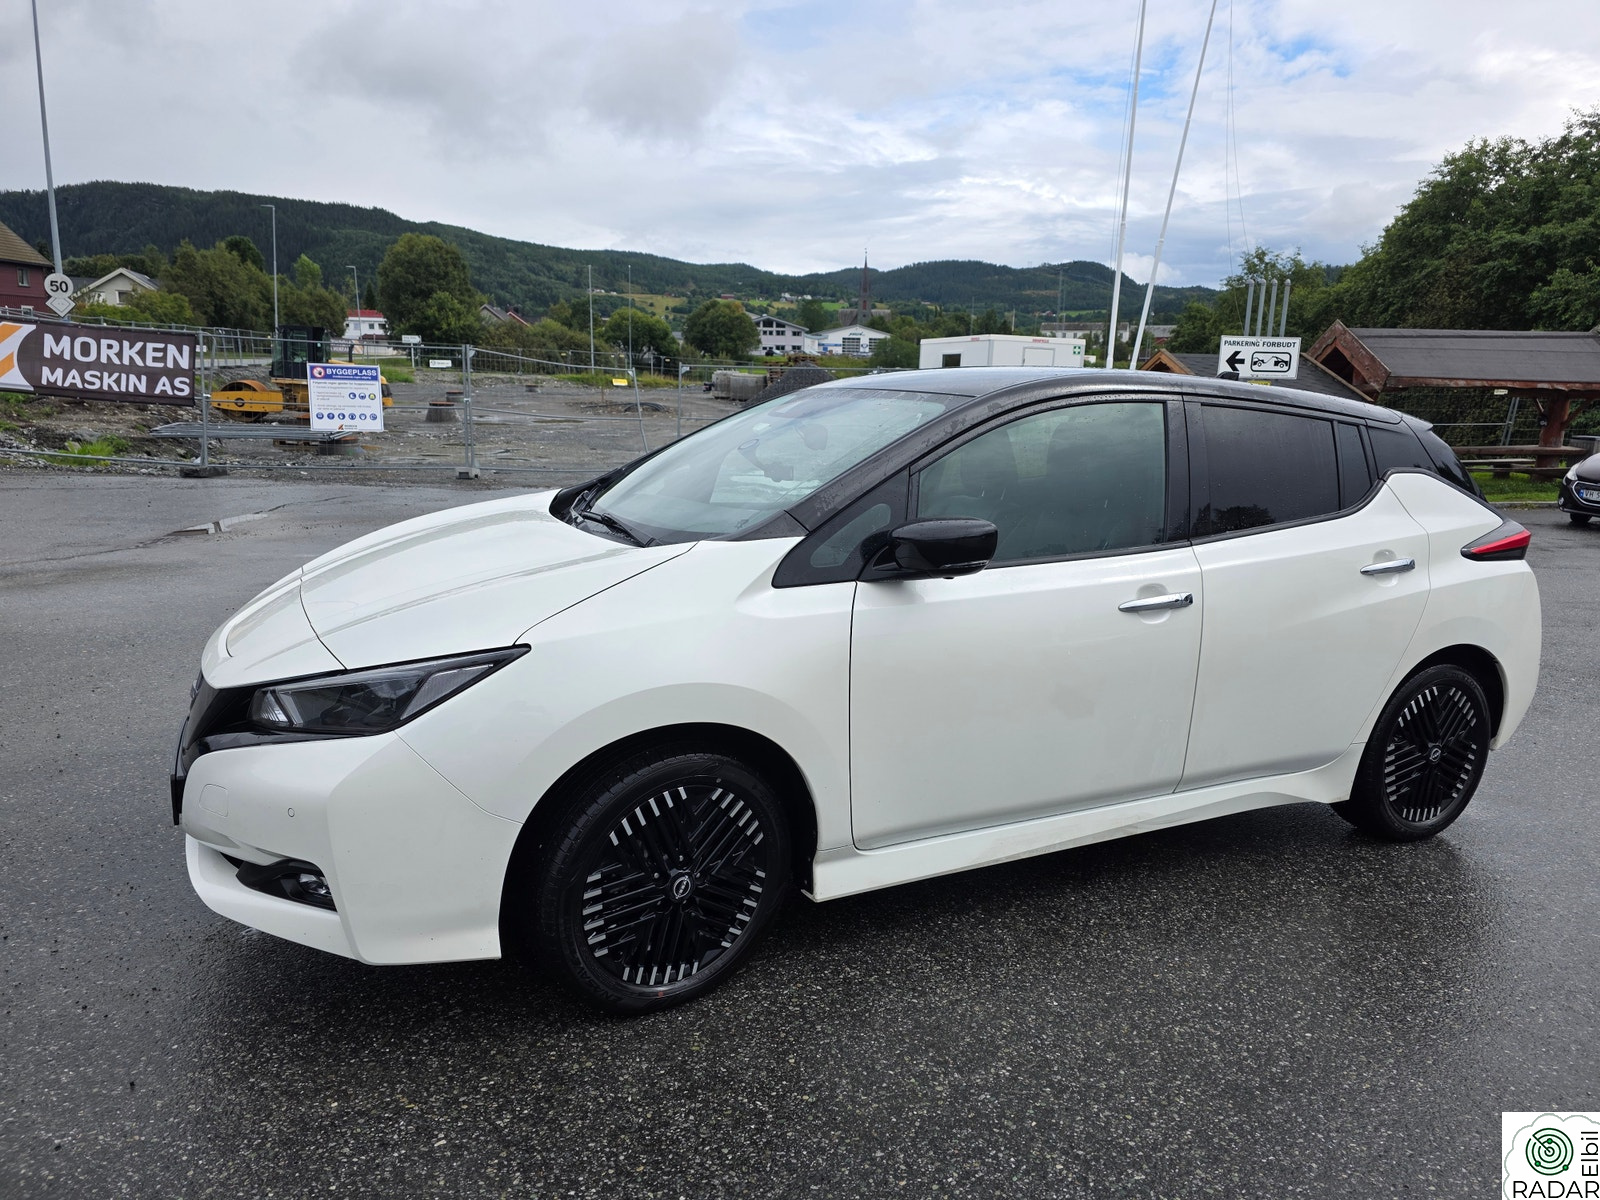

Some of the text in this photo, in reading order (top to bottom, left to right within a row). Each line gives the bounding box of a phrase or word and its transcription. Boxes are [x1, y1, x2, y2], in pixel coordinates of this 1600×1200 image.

[50, 280, 68, 293] 50
[43, 333, 190, 370] MORKEN
[41, 366, 190, 396] MASKIN AS
[326, 368, 377, 376] BYGGEPLASS
